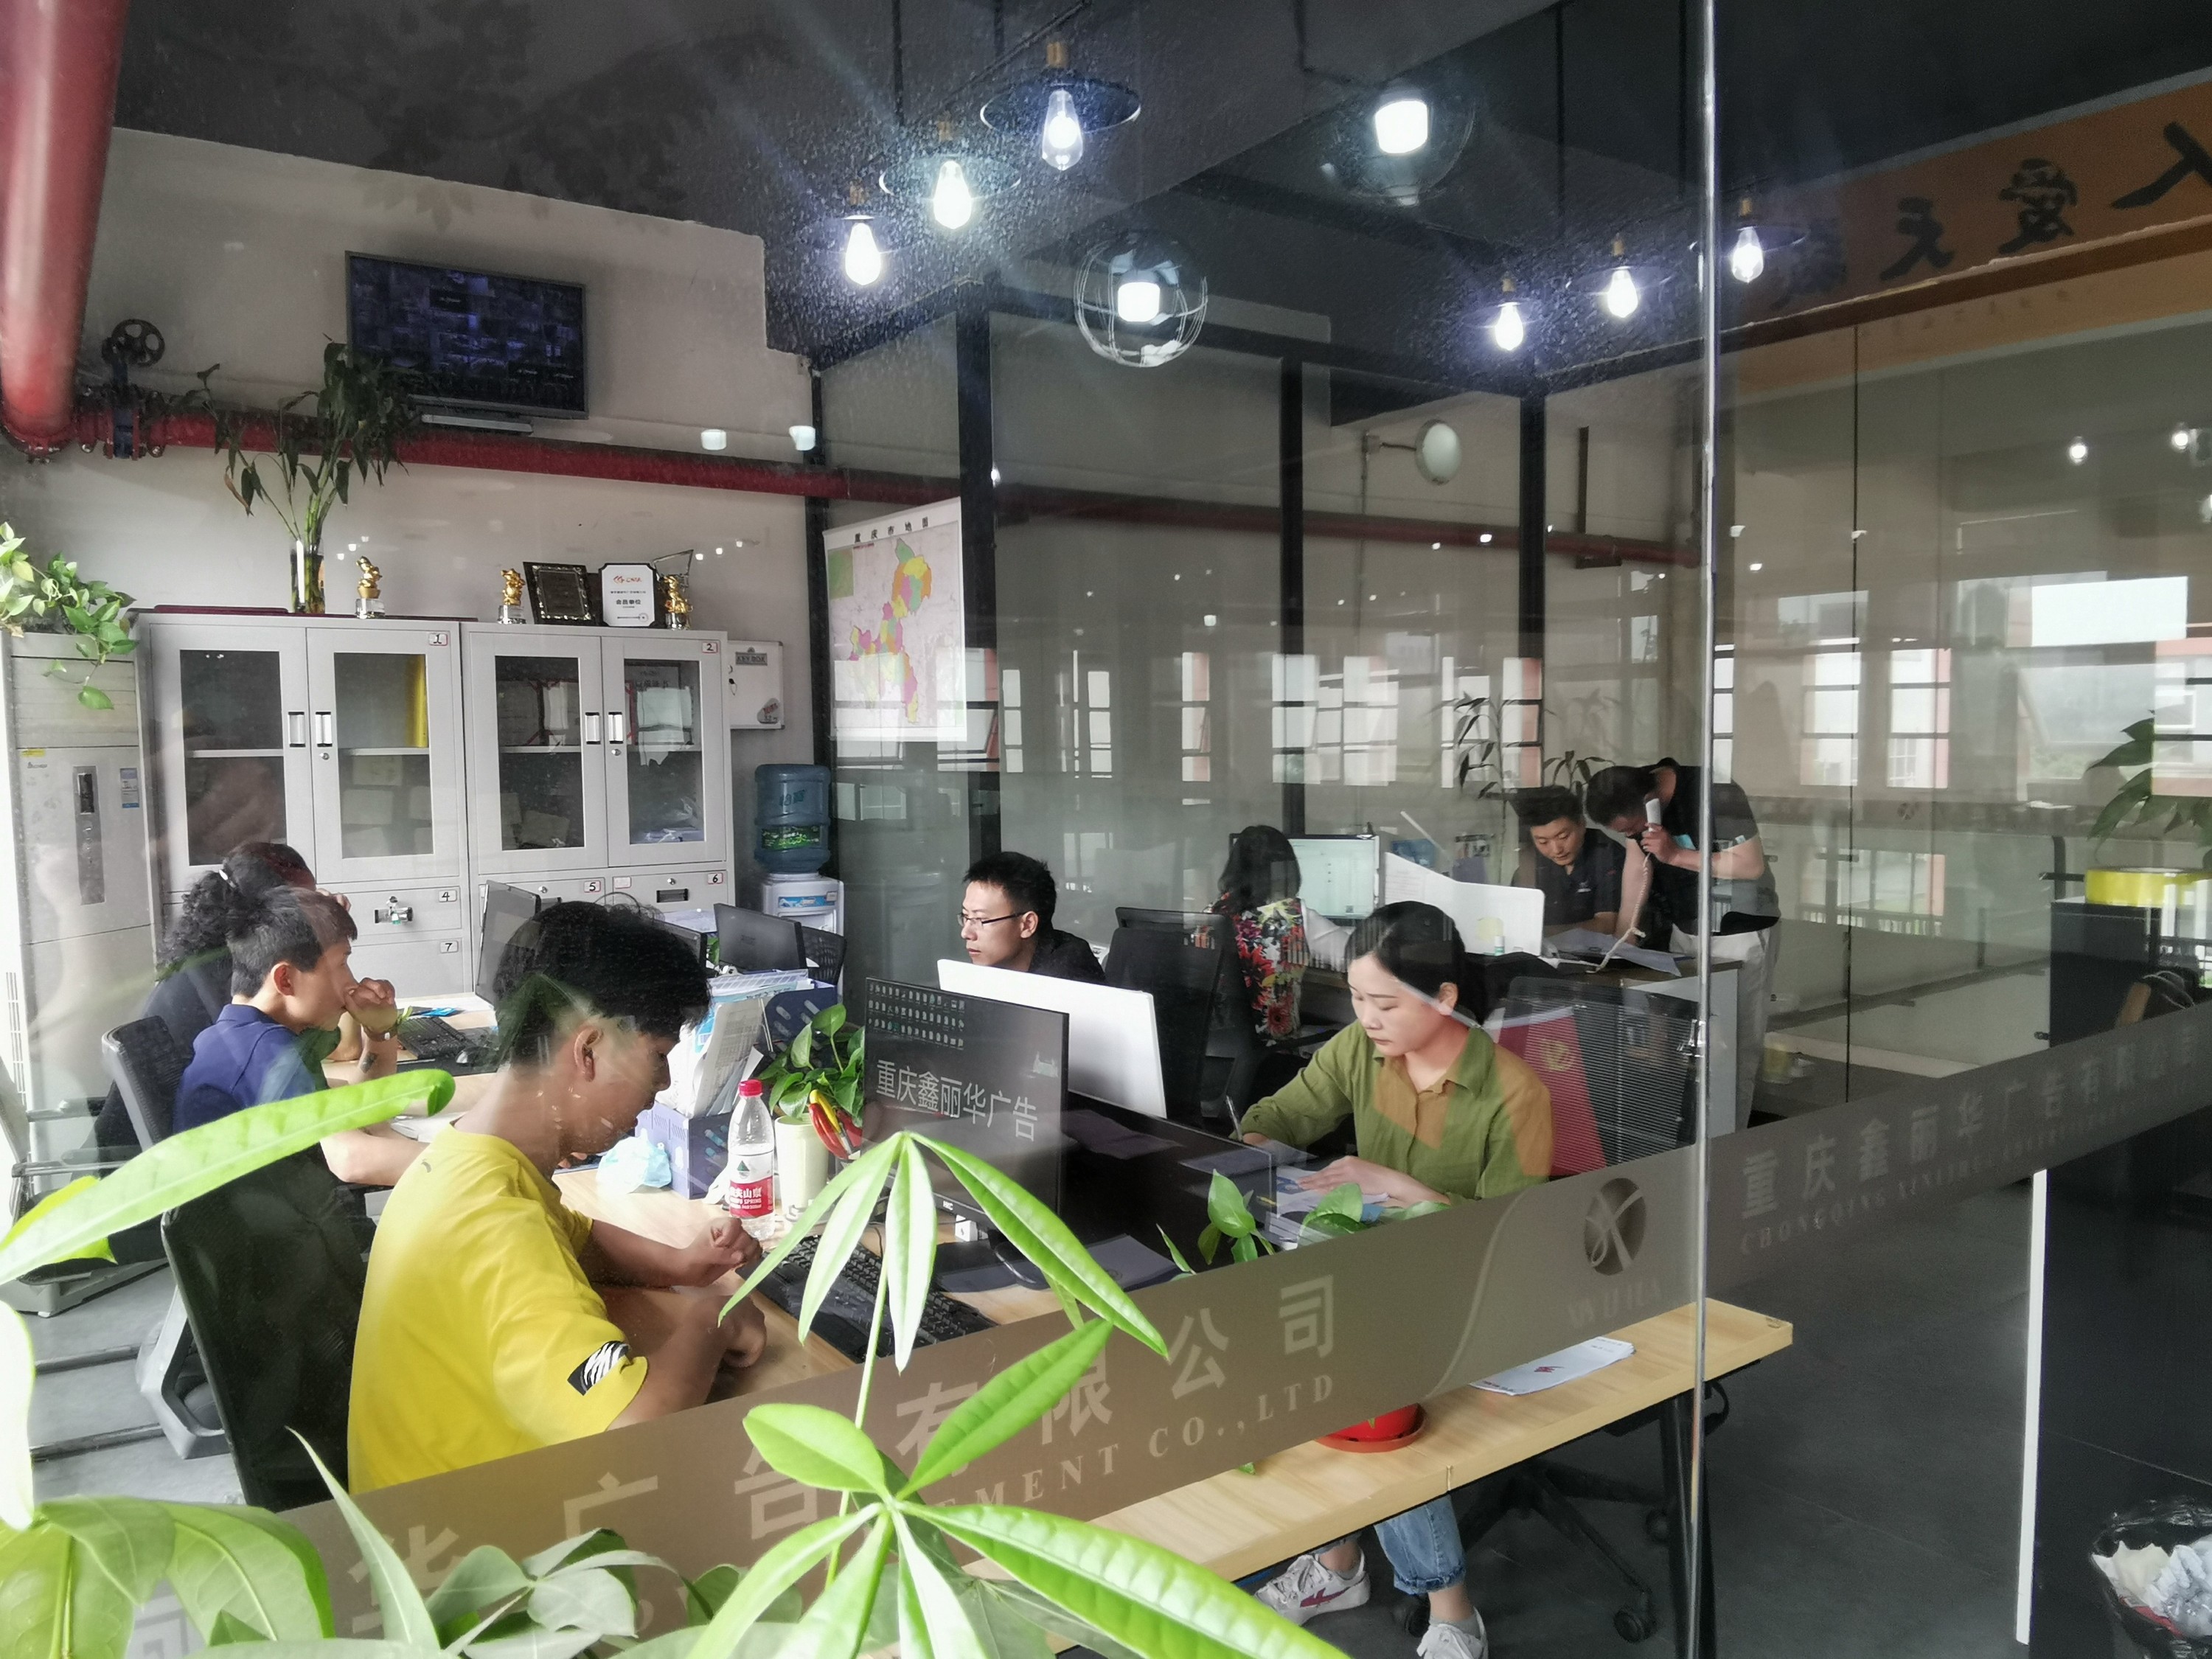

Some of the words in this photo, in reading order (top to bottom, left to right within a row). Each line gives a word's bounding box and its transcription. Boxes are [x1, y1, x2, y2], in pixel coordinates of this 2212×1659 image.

[434, 634, 442, 644] 1
[707, 643, 714, 651] 2
[712, 874, 718, 883] 6
[590, 882, 596, 891] 5
[442, 891, 450, 901] 4
[445, 942, 453, 951] 7
[876, 1060, 1037, 1141] 重庆鑫丽华广告
